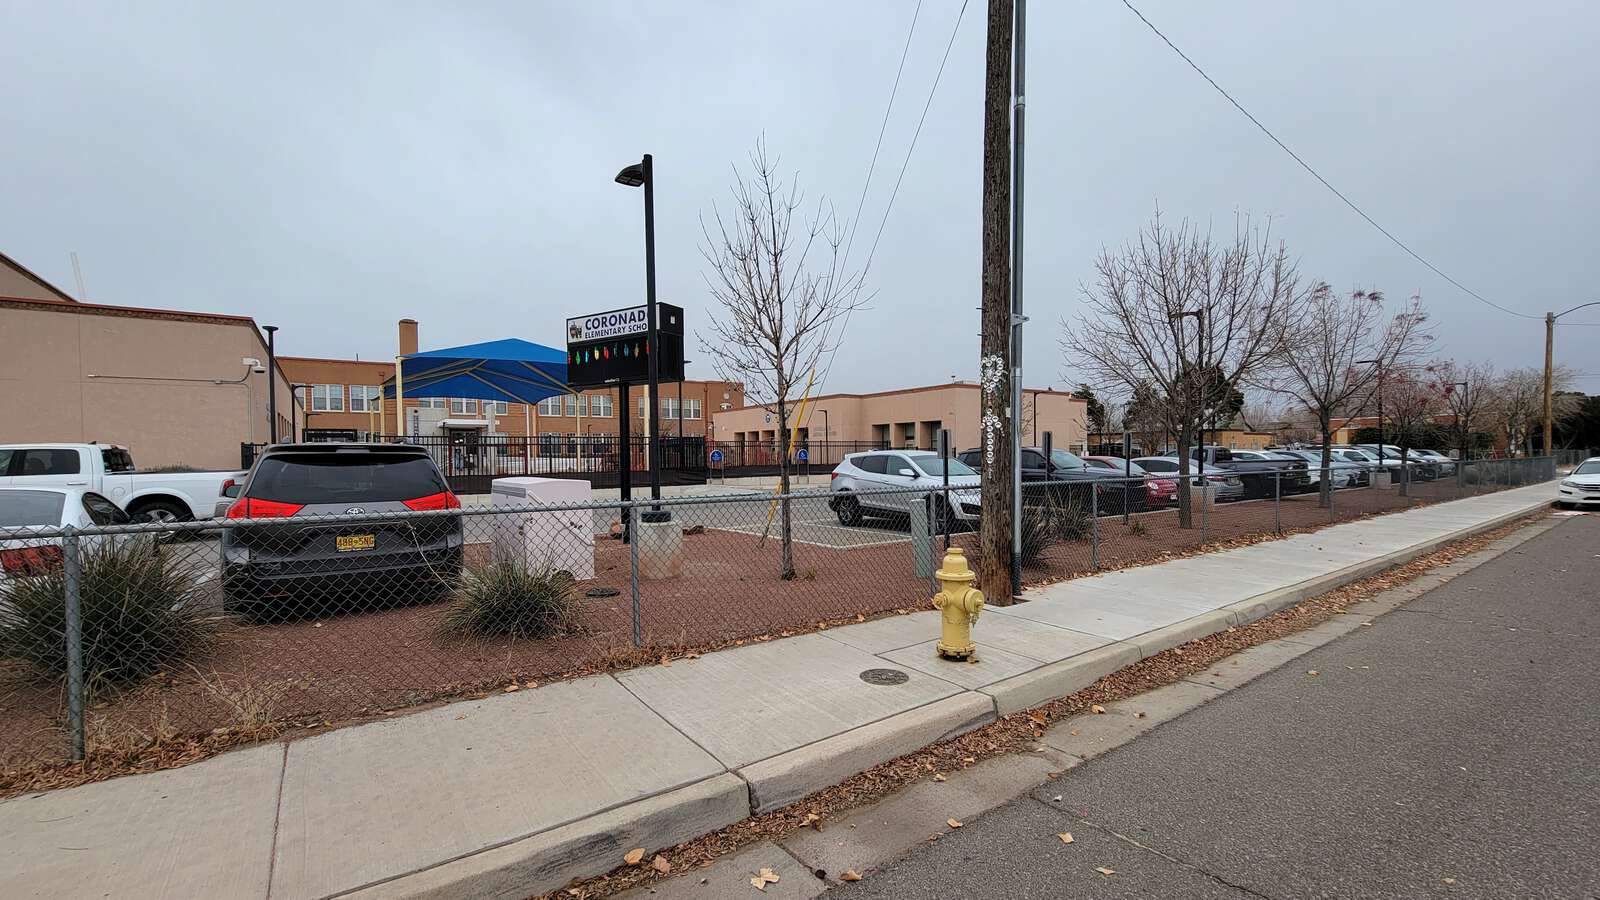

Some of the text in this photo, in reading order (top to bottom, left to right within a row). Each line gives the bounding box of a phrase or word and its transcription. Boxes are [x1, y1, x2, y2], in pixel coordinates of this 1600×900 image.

[585, 309, 648, 331] CORONAD
[584, 322, 648, 339] ELEMENTARY SCHO
